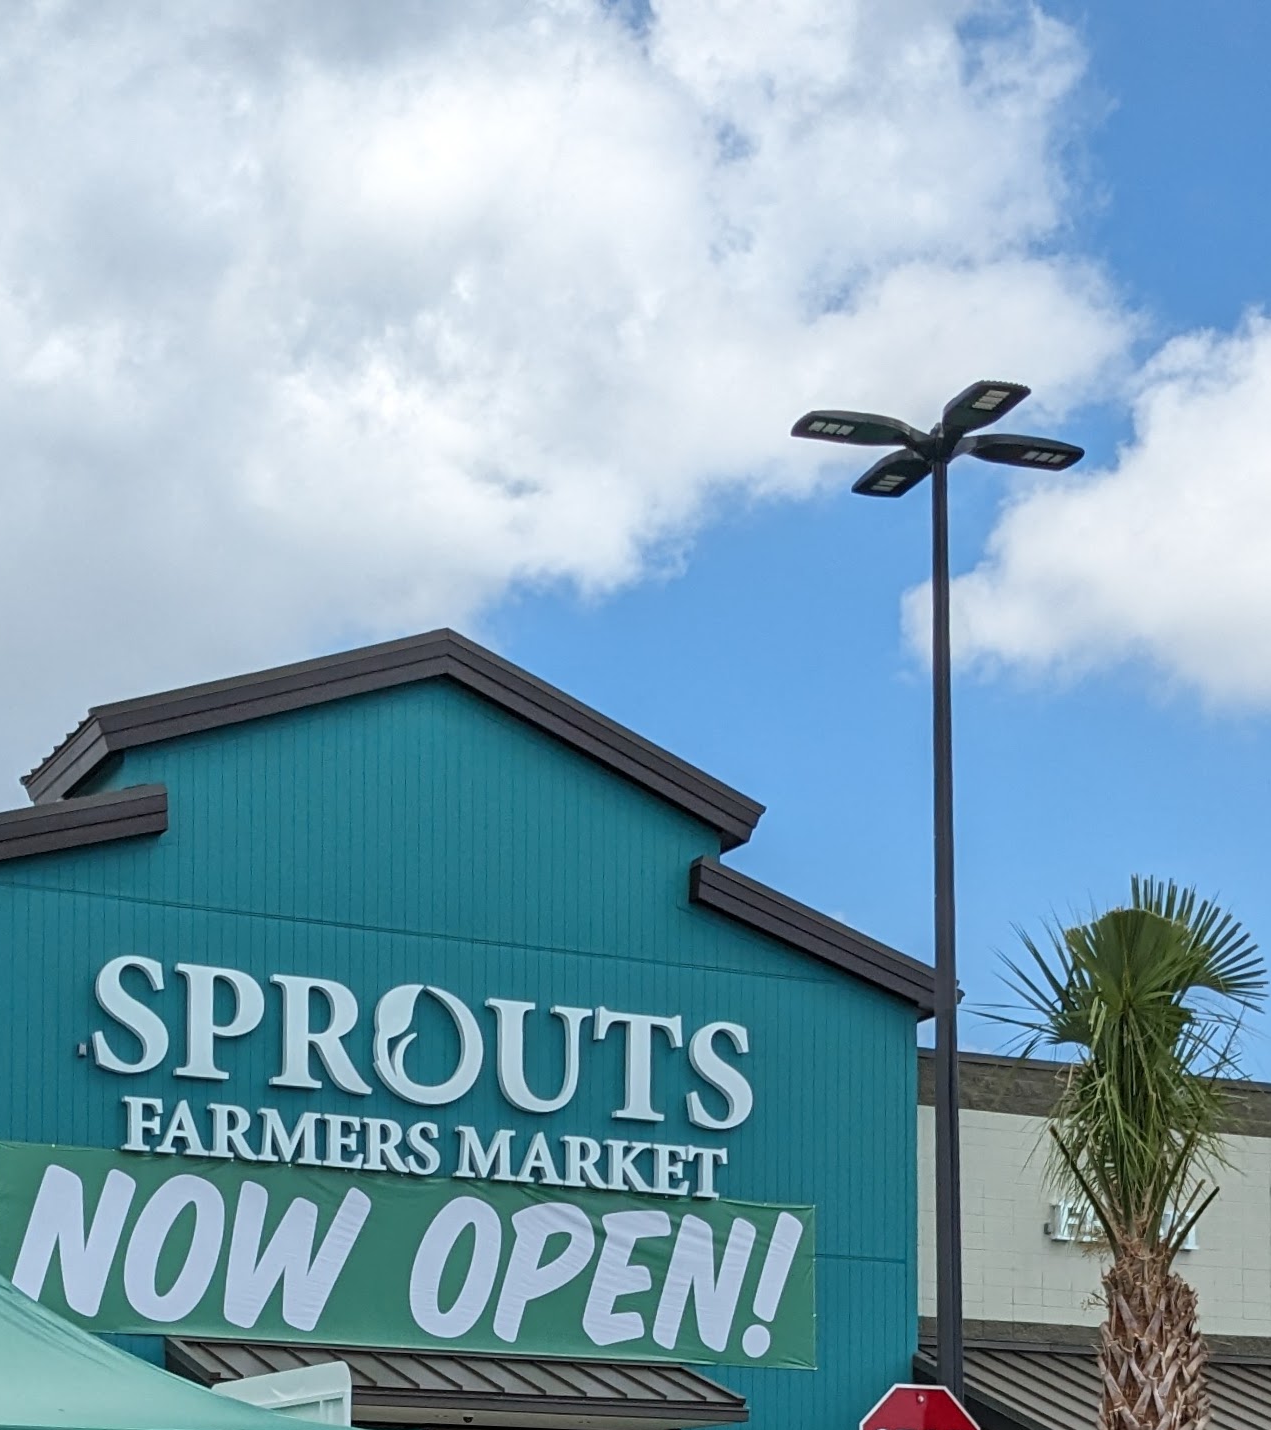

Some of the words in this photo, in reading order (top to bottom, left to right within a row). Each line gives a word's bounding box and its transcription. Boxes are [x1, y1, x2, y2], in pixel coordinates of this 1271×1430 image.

[92, 955, 753, 1131] SPROUTS
[120, 1095, 441, 1176] FARMERS
[453, 1125, 727, 1200] MARKET
[12, 1165, 372, 1333] NOW
[409, 1196, 804, 1359] OPEN!
